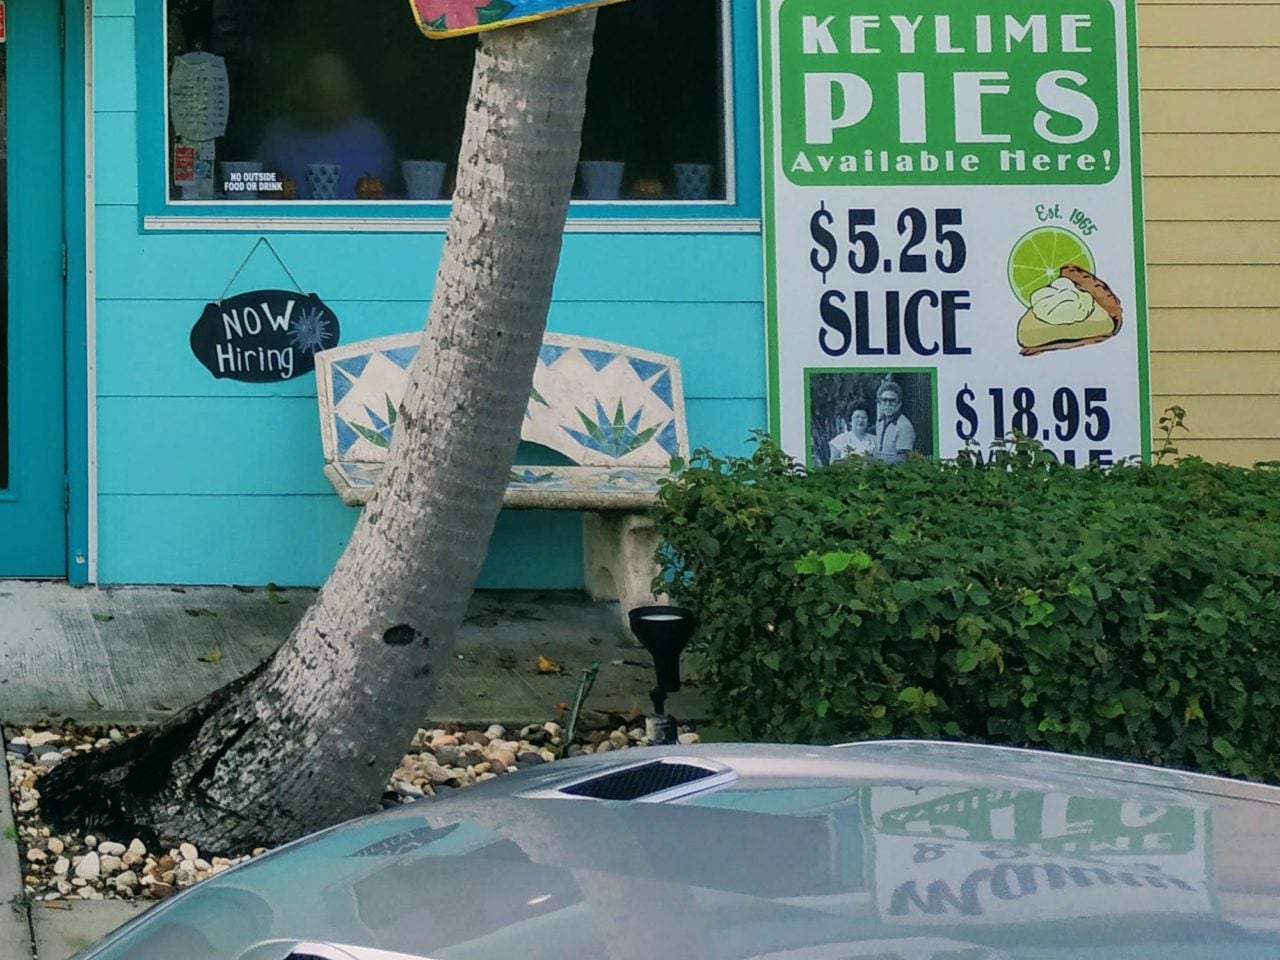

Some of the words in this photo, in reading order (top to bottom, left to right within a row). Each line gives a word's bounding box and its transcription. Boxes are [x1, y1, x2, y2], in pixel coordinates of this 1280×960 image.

[802, 14, 1092, 54] KEYLIME
[804, 70, 1099, 144] PIES
[230, 172, 242, 181] NO
[243, 172, 276, 181] OUTSIDE
[791, 149, 980, 172] Available
[1000, 149, 1112, 172] Here!
[224, 182, 245, 191] FOOD
[246, 182, 257, 191] OR
[259, 182, 283, 191] DRINK
[1035, 203, 1063, 222] Est.
[1069, 207, 1099, 236] 1965
[810, 200, 967, 284] $5.25
[222, 300, 296, 340] NOW
[819, 289, 972, 356] SLICE
[216, 343, 294, 379] Hiring
[956, 383, 1111, 441] $18.95
